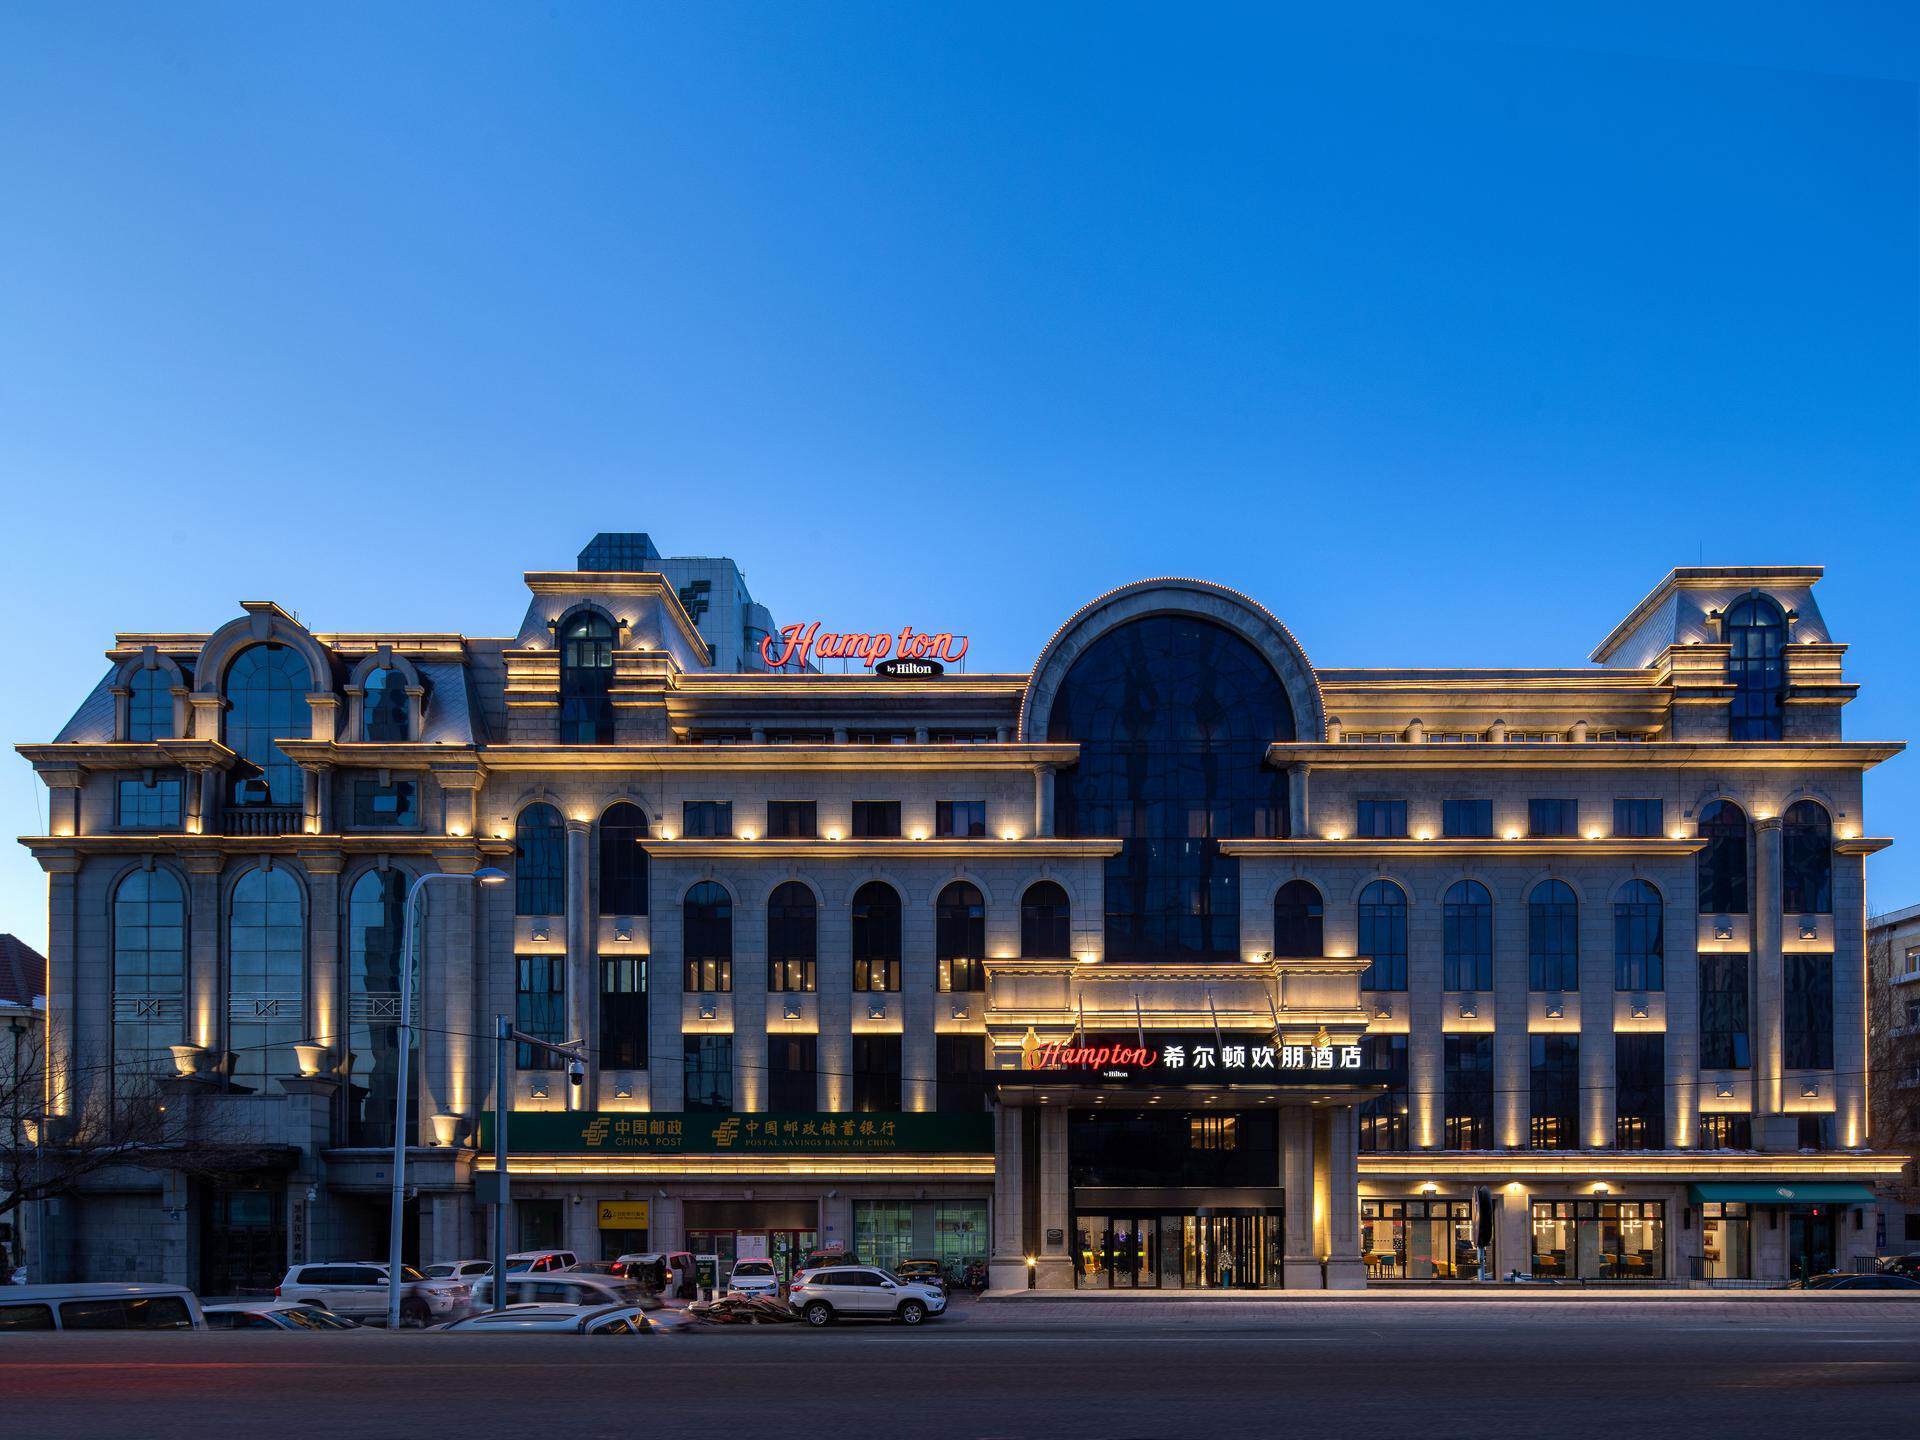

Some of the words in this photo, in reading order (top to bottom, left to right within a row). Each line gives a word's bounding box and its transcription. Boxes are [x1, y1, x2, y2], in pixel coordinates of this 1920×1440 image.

[761, 621, 969, 668] Hampton
[887, 665, 896, 674] by
[897, 663, 932, 674] Hilton
[1028, 1040, 1157, 1070] Hampton
[1163, 1045, 1362, 1069] 希尔顿欢朋酒店
[615, 1119, 682, 1136] 中国邮政
[745, 1119, 896, 1137] 中国邮政储蓄银行
[615, 1138, 650, 1146] CHINA
[656, 1138, 682, 1146] POST
[745, 1139, 780, 1147] POSTAL
[783, 1139, 824, 1147] SAVINGS
[825, 1139, 850, 1147] BANK
[852, 1139, 864, 1147] OF
[867, 1139, 896, 1147] CHINA
